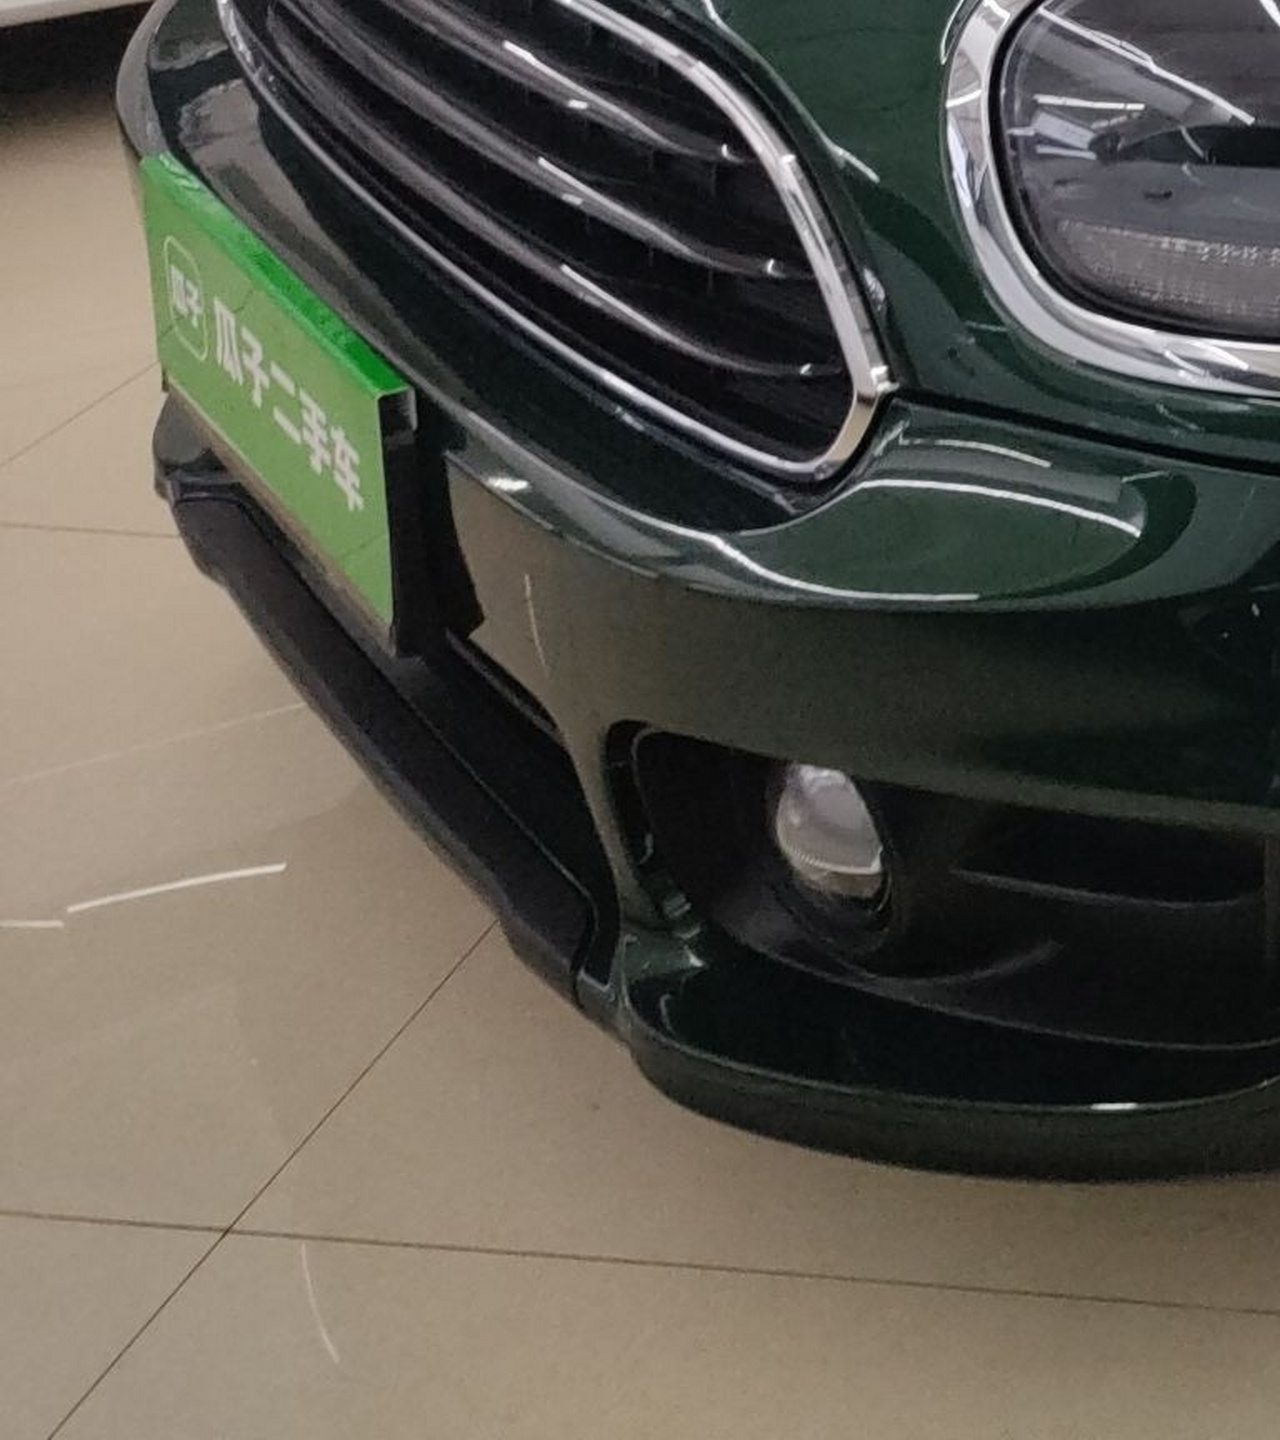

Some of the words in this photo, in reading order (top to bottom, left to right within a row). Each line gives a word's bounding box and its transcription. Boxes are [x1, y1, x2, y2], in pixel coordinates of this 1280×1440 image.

[170, 265, 204, 328] 瓜子
[214, 296, 364, 512] 瓜子二手车
